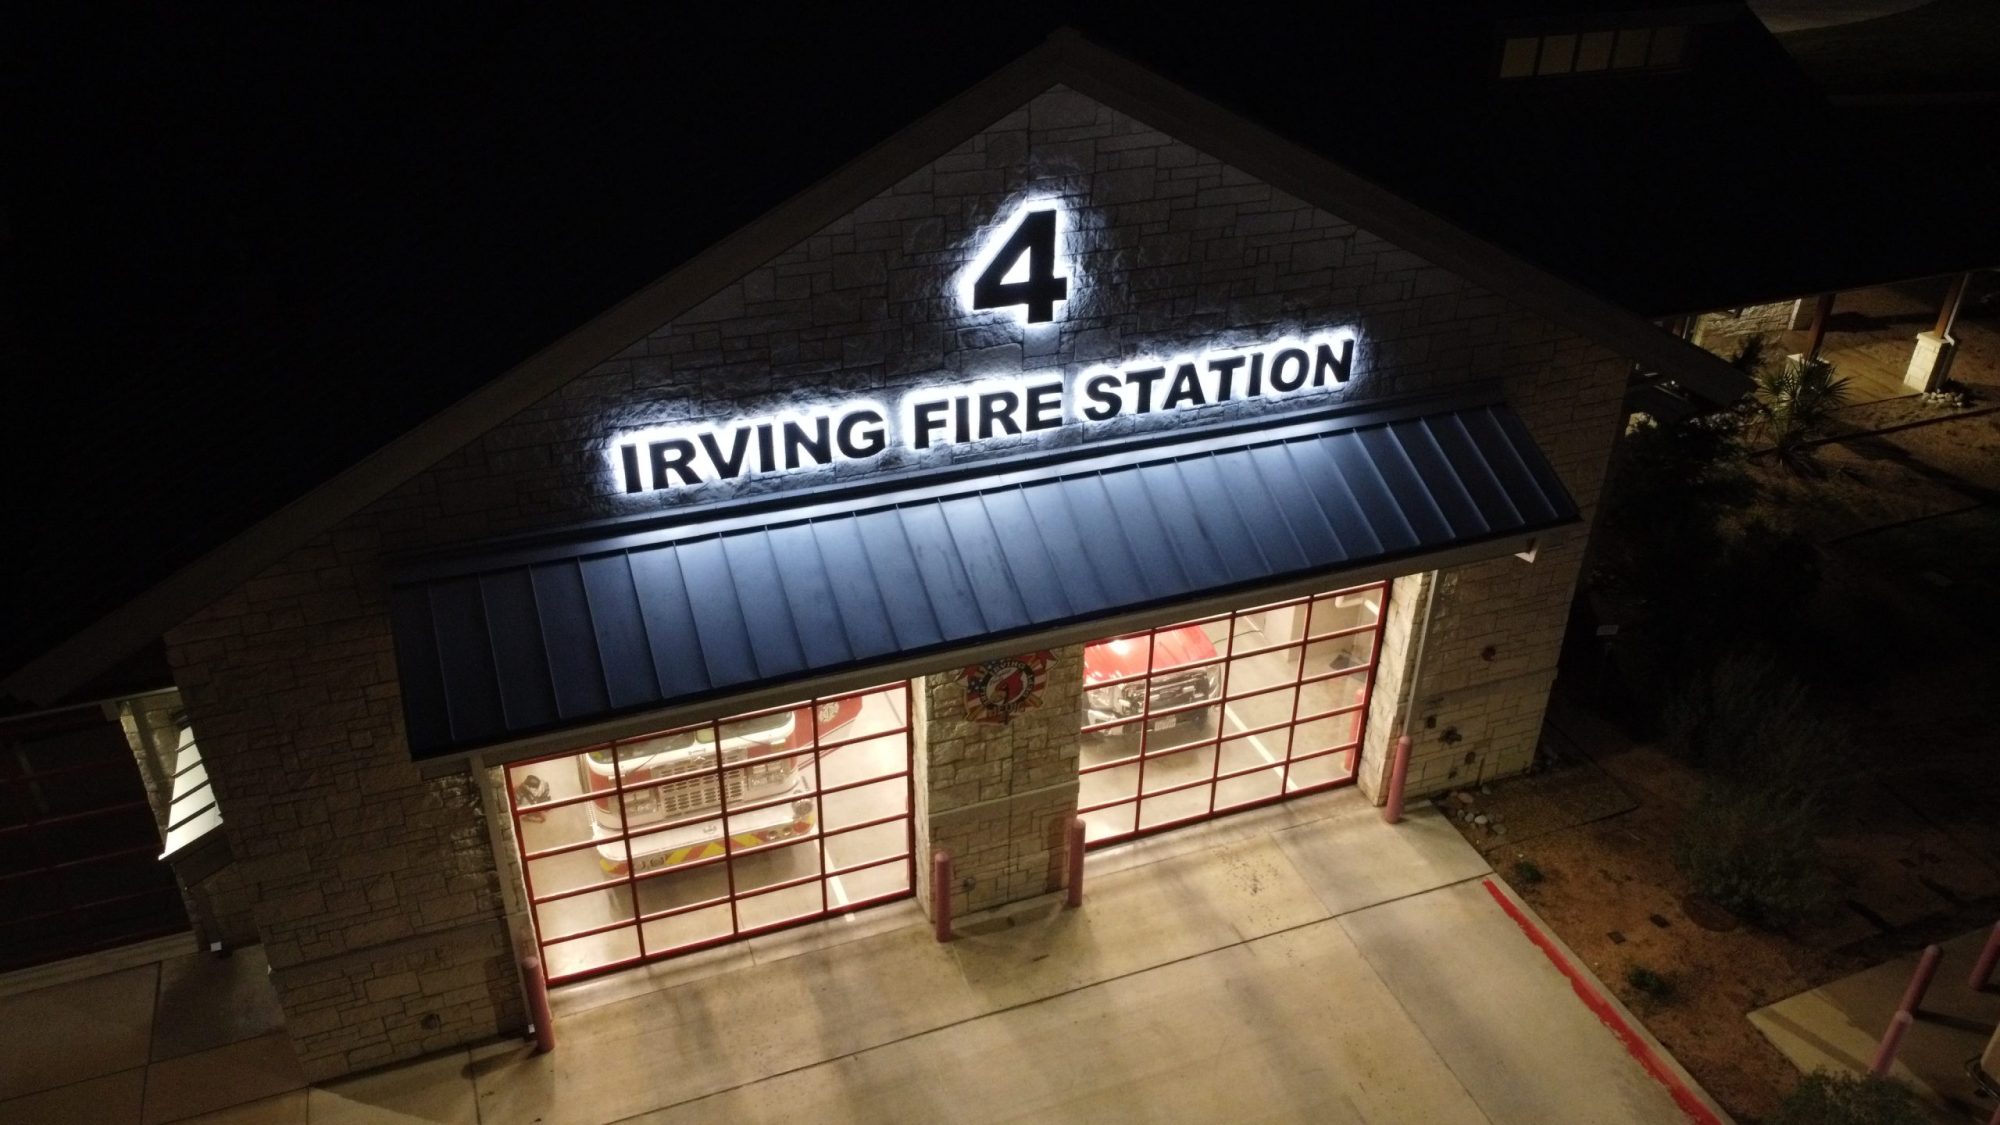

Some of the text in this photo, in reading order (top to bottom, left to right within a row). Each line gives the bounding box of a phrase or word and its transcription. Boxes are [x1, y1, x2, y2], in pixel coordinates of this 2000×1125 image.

[973, 208, 1067, 324] 4
[620, 338, 1355, 494] IRVING FIRE STATION
